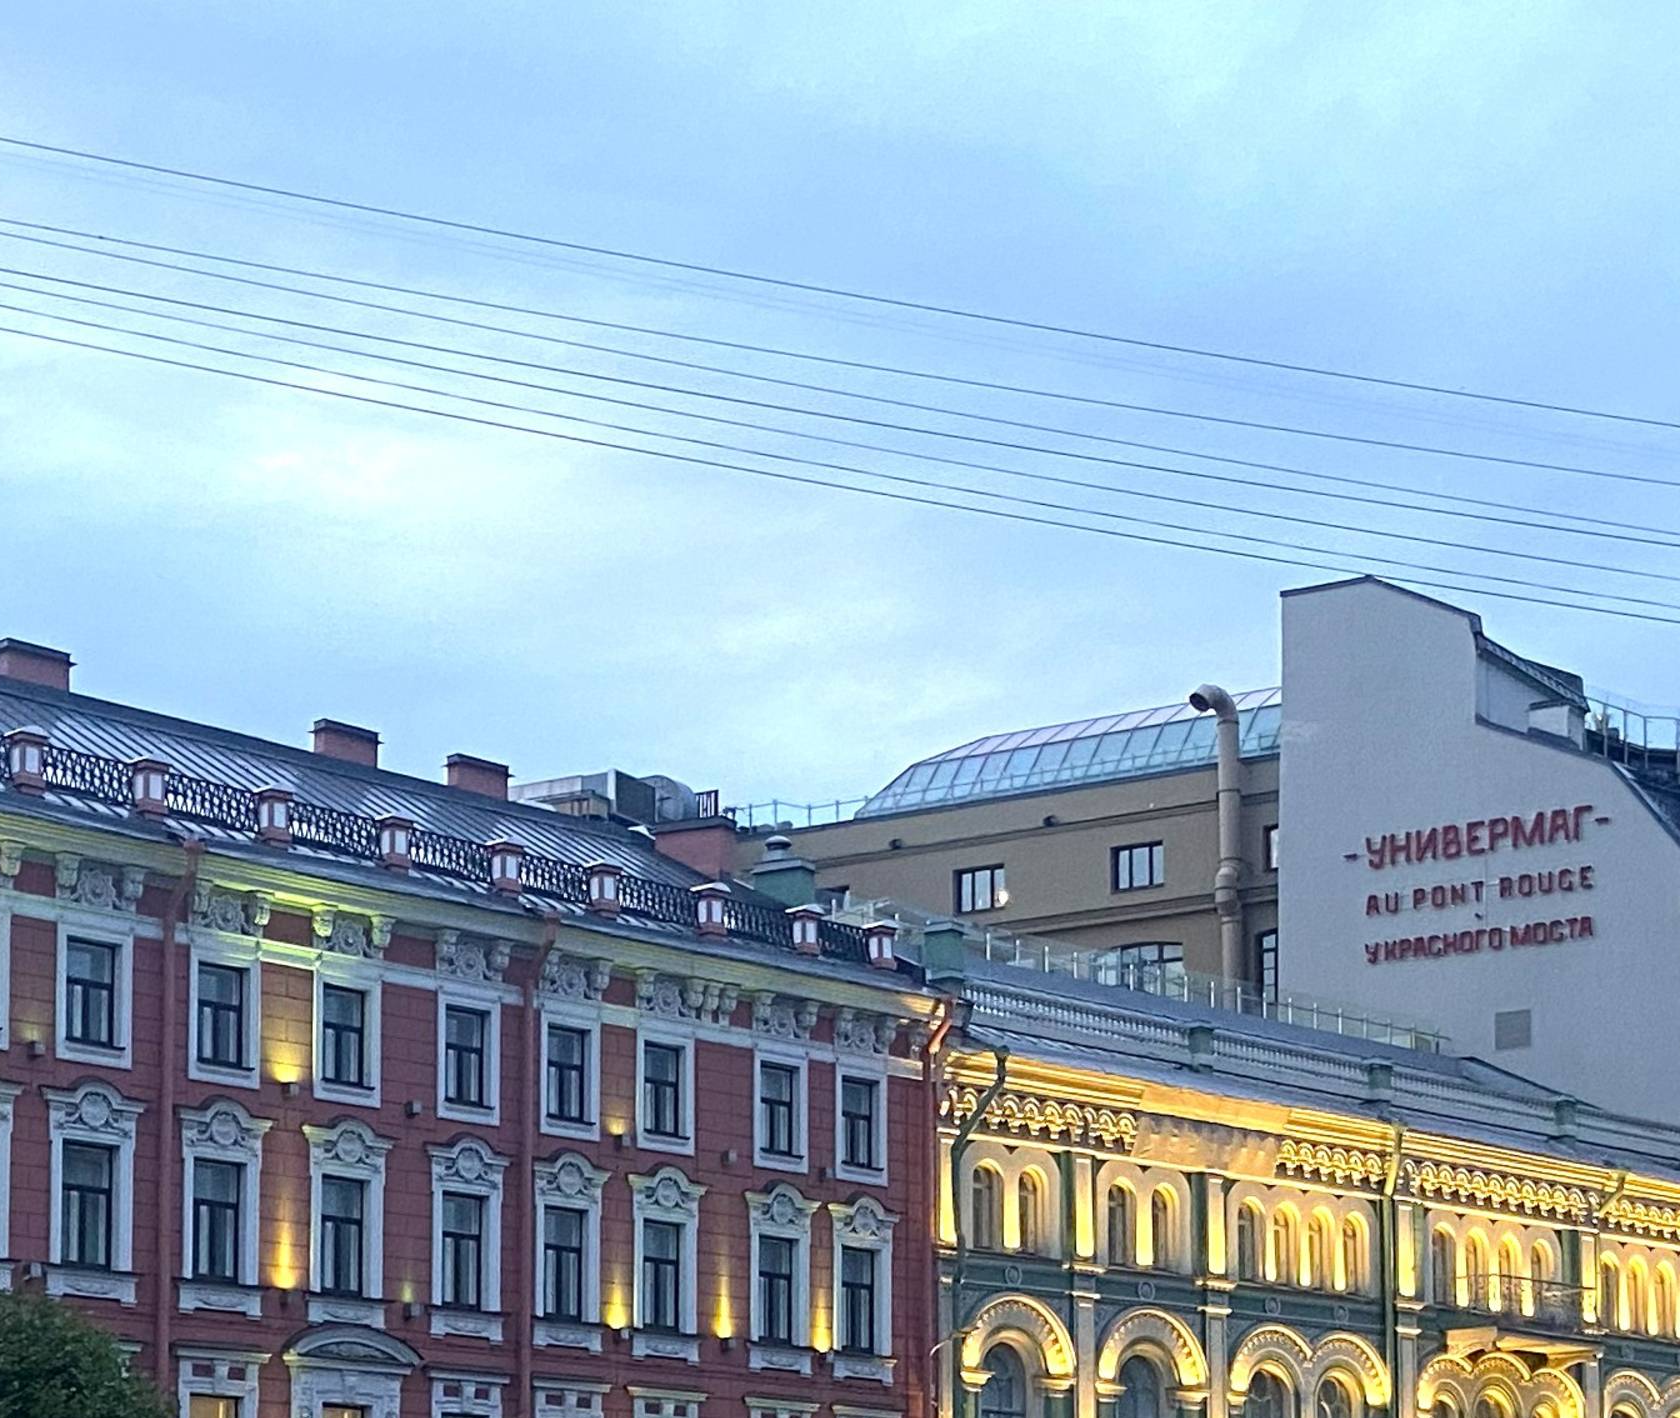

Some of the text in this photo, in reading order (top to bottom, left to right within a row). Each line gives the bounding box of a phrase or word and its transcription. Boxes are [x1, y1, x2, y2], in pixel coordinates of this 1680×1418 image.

[1365, 804, 1593, 869] УНИВЕРМАГ
[1366, 865, 1594, 915] AU PONT ROUGE
[1384, 926, 1503, 961] КРАСНОГО
[1510, 916, 1593, 946] МОСТА
